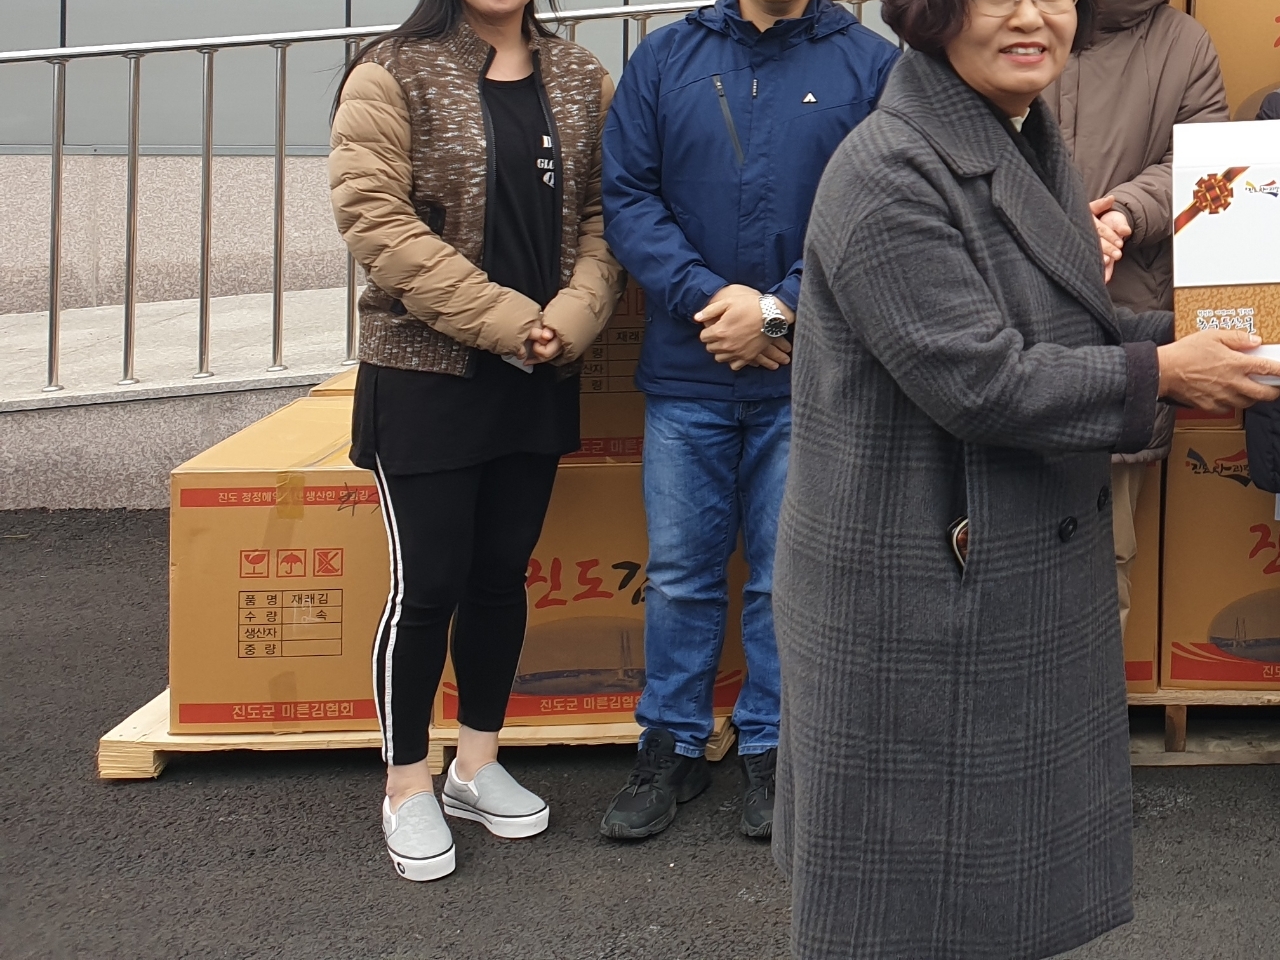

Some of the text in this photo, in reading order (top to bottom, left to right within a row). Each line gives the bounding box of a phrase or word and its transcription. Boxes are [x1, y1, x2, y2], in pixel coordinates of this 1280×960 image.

[616, 330, 645, 342] 재래
[583, 363, 603, 376] 산자
[218, 492, 238, 504] 진도
[244, 593, 329, 606] 품 명 재래김
[244, 609, 328, 623] 수 량 속
[244, 626, 277, 640] 생산자
[244, 643, 277, 656] 중 량
[232, 701, 355, 720] 진도군 마른김협회
[539, 698, 578, 712] 진도군
